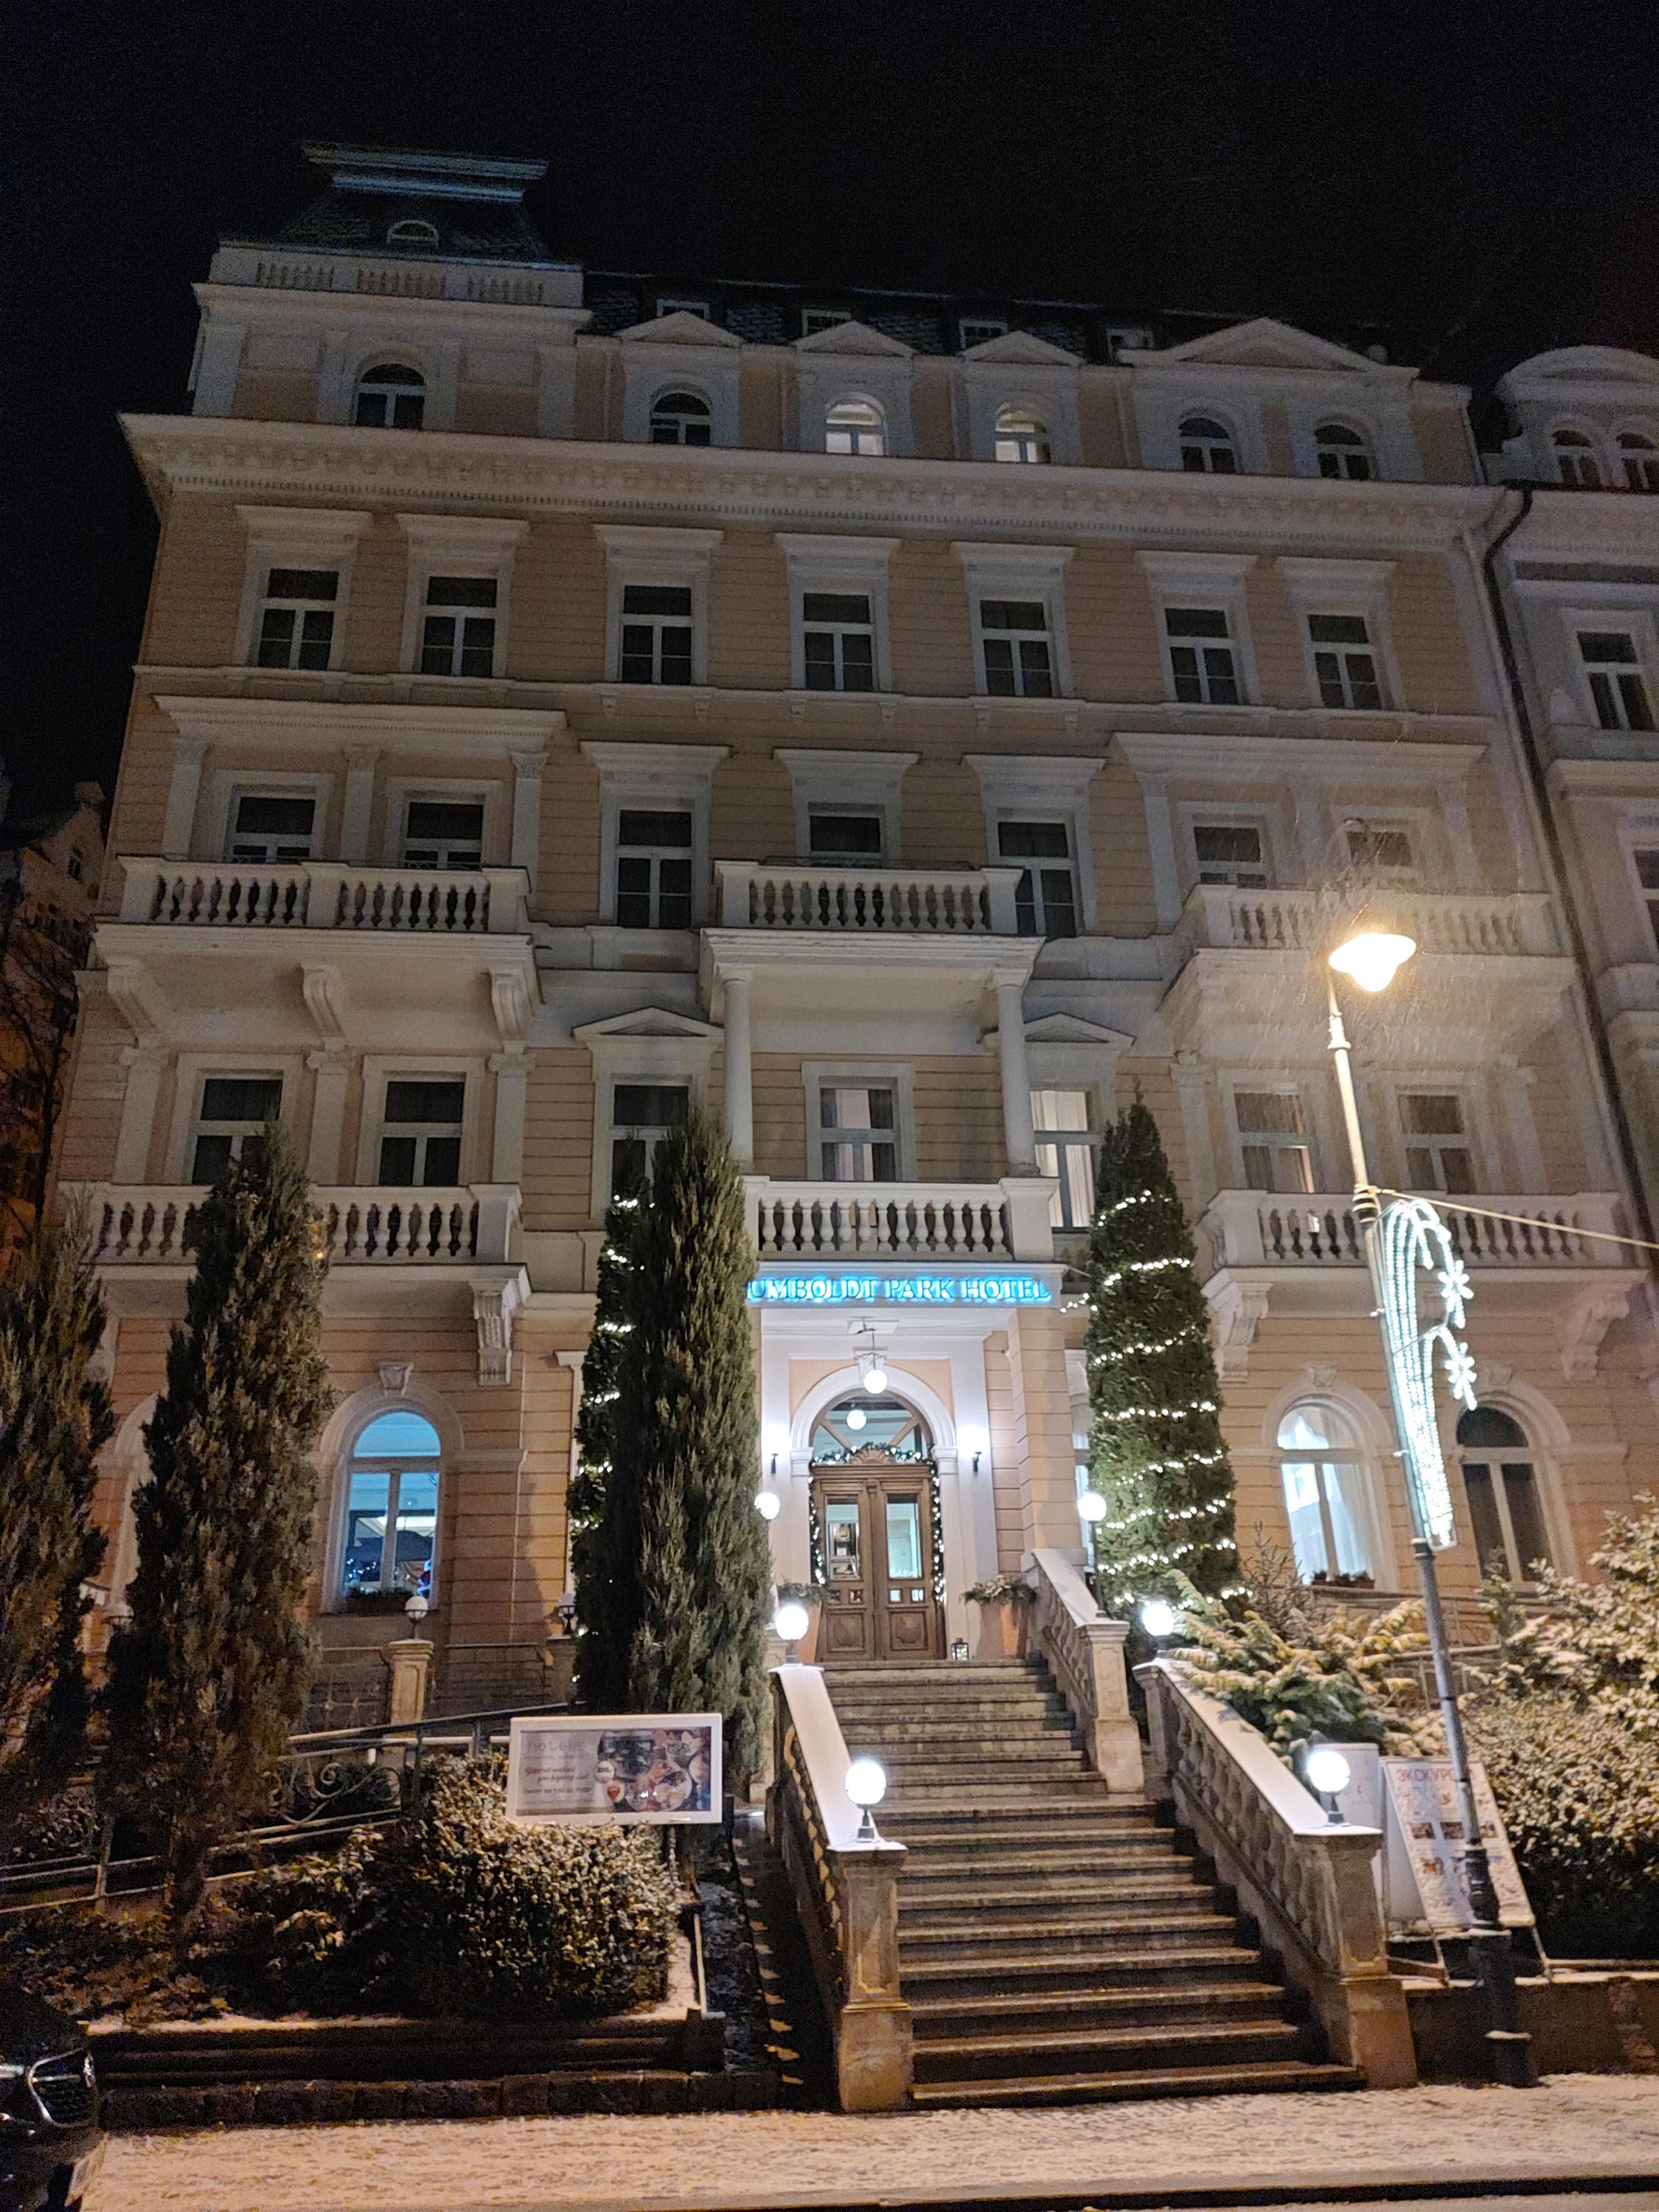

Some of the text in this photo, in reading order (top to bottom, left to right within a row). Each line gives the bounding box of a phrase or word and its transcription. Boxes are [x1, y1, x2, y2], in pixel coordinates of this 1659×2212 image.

[748, 1278, 1051, 1300] UMBOLDT PARK HOTEL
